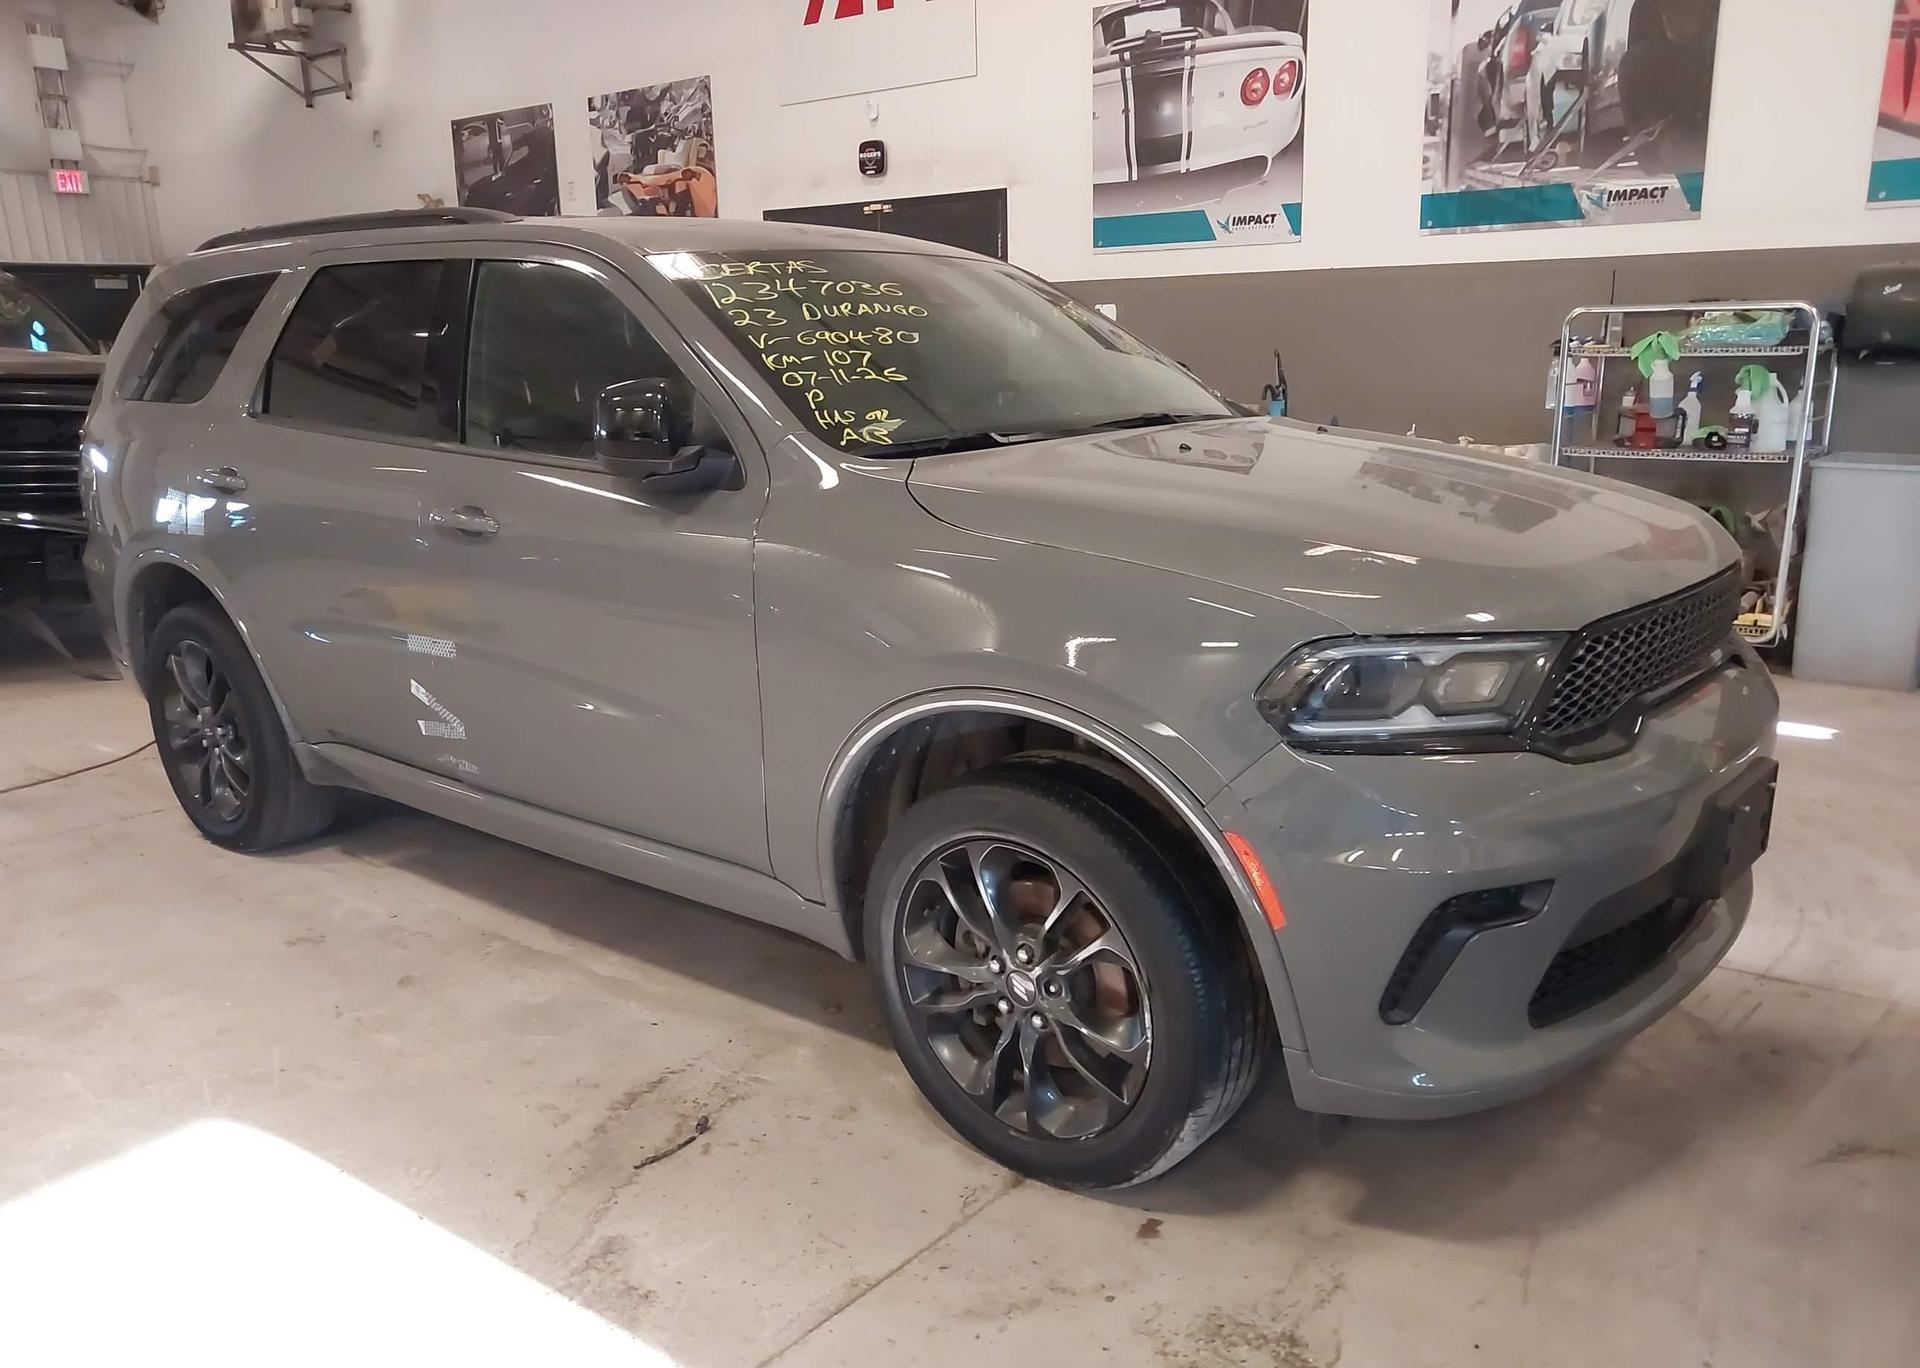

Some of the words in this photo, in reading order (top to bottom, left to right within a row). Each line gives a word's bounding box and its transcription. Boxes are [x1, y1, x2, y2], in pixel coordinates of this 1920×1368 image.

[1607, 186, 1669, 202] IMPACT
[1231, 213, 1278, 227] IMPACT
[728, 308, 788, 327] 23
[802, 302, 929, 321] DURANGO
[804, 388, 825, 410] P
[814, 409, 857, 430] HAS
